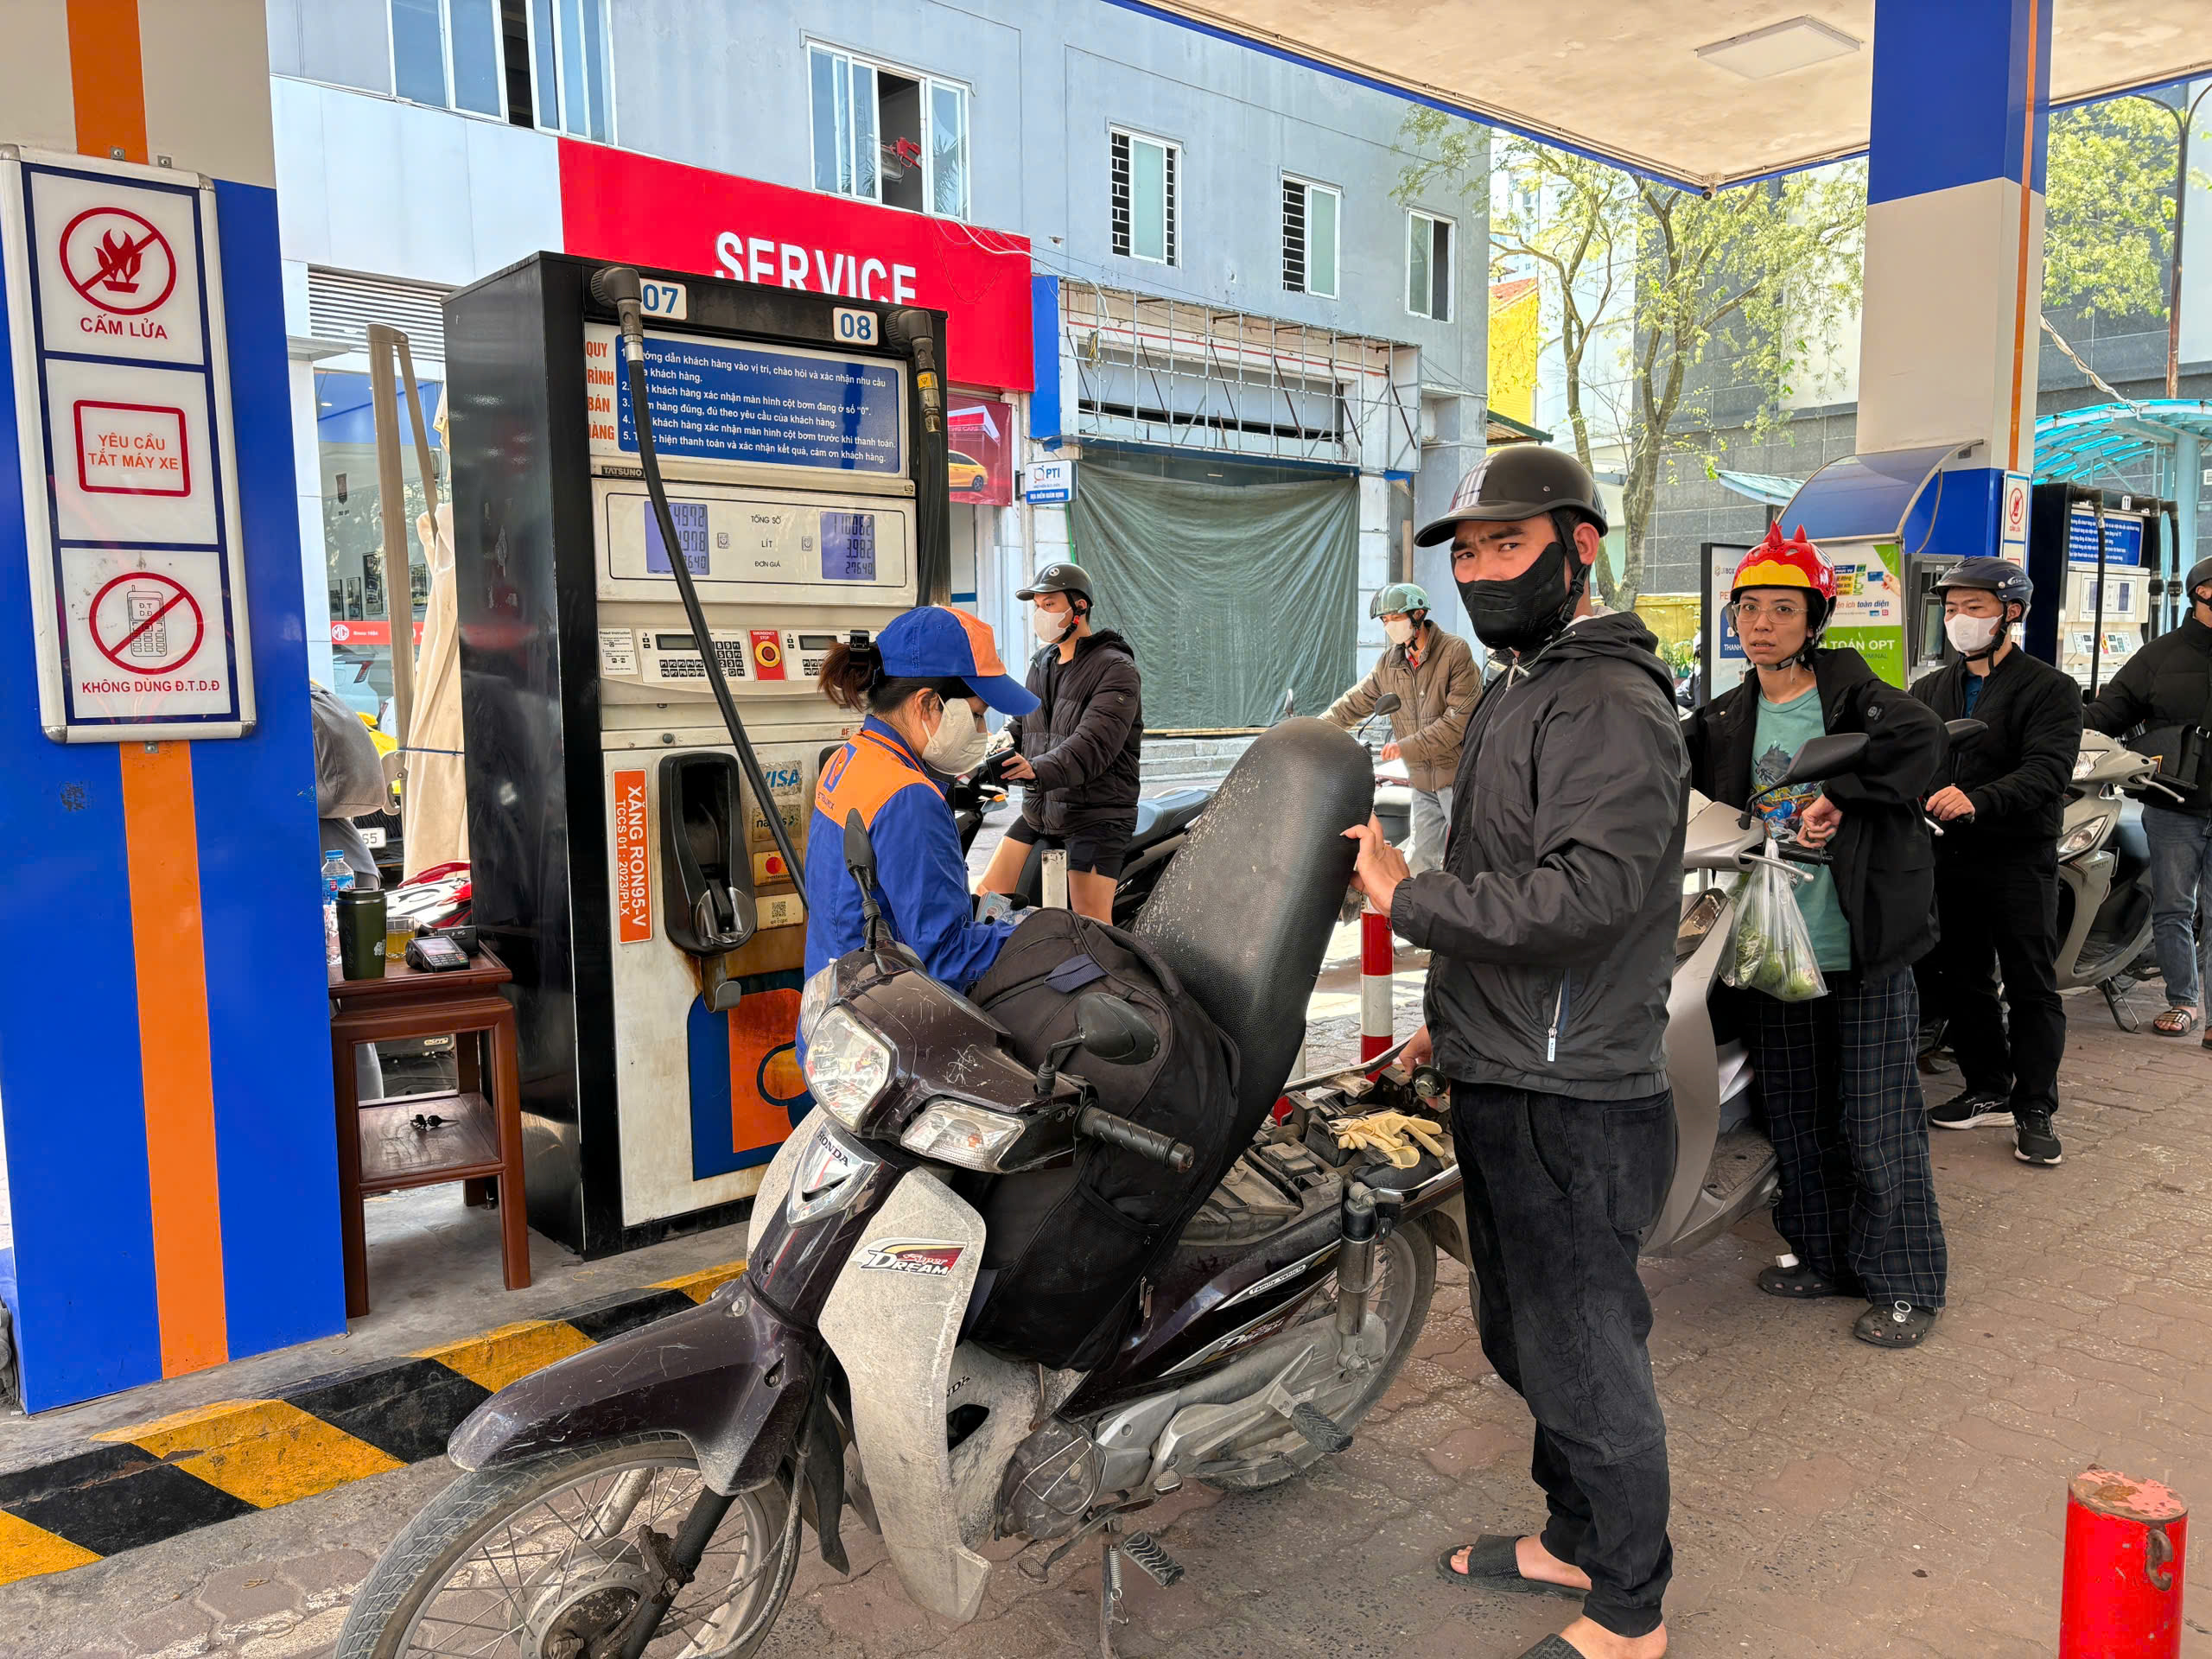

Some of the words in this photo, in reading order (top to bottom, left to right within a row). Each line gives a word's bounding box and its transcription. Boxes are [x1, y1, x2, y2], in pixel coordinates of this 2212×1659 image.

[715, 232, 917, 305] SERVICE
[642, 284, 678, 314] 07
[80, 314, 123, 335] CẤM
[130, 318, 168, 340] LỬA
[840, 313, 871, 340] 08
[586, 340, 607, 358] QUY
[587, 366, 614, 386] RÌNH
[650, 367, 677, 379] khách
[679, 372, 702, 384] hàng.
[665, 352, 681, 363] dẫn
[683, 355, 709, 366] khách
[711, 359, 732, 371] hàng
[734, 362, 749, 371] vào
[751, 364, 759, 374] vị
[773, 366, 792, 377] chào
[795, 367, 807, 378] hỏi
[809, 370, 818, 379] và
[820, 372, 834, 381] xác
[836, 373, 854, 385] nhận
[856, 377, 871, 385] nhu
[873, 377, 886, 387] cầu
[588, 394, 610, 413] BÁN
[621, 381, 630, 391] 2.
[652, 385, 677, 396] khách
[680, 388, 701, 399] hàng
[703, 391, 718, 399] xác
[721, 391, 741, 404] nhận
[743, 394, 760, 404] màn
[763, 395, 781, 406] hình
[783, 398, 795, 409] cột
[798, 400, 815, 410] bơm
[817, 402, 836, 413] đang
[846, 404, 855, 414] số
[622, 398, 630, 407] 3.
[657, 401, 677, 414] hàng
[720, 408, 739, 418] theo
[741, 410, 755, 422] yêu
[757, 411, 772, 422] cầu
[774, 413, 788, 423] của
[791, 415, 813, 425] khách
[816, 417, 837, 429] hàng.
[622, 415, 631, 423] 4.
[652, 417, 678, 429] khách
[681, 420, 702, 432] hàng
[704, 423, 719, 431] xác
[721, 424, 741, 435] nhận
[744, 427, 761, 436] màn
[783, 430, 796, 441] cột
[798, 432, 816, 442] bơm
[817, 434, 839, 443] trước
[842, 435, 852, 444] khi
[855, 436, 875, 447] thanh
[98, 432, 129, 448] YÊU
[134, 433, 165, 451] CẦU
[623, 431, 632, 441] 5.
[659, 434, 677, 446] hiện
[680, 436, 704, 447] thanh
[706, 438, 725, 448] toán
[727, 440, 737, 449] và
[739, 442, 753, 450] xác
[755, 442, 775, 453] nhận
[777, 442, 790, 454] kết
[829, 449, 839, 458] ơn
[841, 450, 863, 460] khách
[866, 452, 887, 463] hàng.
[87, 448, 118, 467] TẮT
[122, 453, 155, 468] MÁY
[159, 457, 179, 470] XE
[604, 467, 643, 477] TATSUNO
[1046, 467, 1060, 480] PTI
[669, 505, 706, 527] 4972
[751, 514, 770, 524] TỔNG
[772, 515, 782, 524] SỐ
[761, 538, 772, 548] LÍT
[684, 556, 707, 569] 640
[846, 562, 873, 575] 27640
[1857, 600, 1872, 608] toàn
[1874, 599, 1889, 609] diện
[333, 625, 349, 640] MG
[1830, 639, 1865, 650] TOÁN
[1869, 640, 1895, 650] OPT
[82, 679, 130, 693] KHÔNG
[135, 677, 172, 692] DÙNG
[175, 680, 219, 692] Đ.T.D.Đ
[617, 799, 626, 834] TCCS
[627, 785, 645, 841] XĂNG
[756, 817, 787, 828] nas
[618, 836, 627, 850] 01
[619, 861, 630, 916] 2023/PLX
[630, 846, 646, 927] RON95-V
[817, 1131, 849, 1167] HONDA
[902, 1253, 949, 1265] Super
